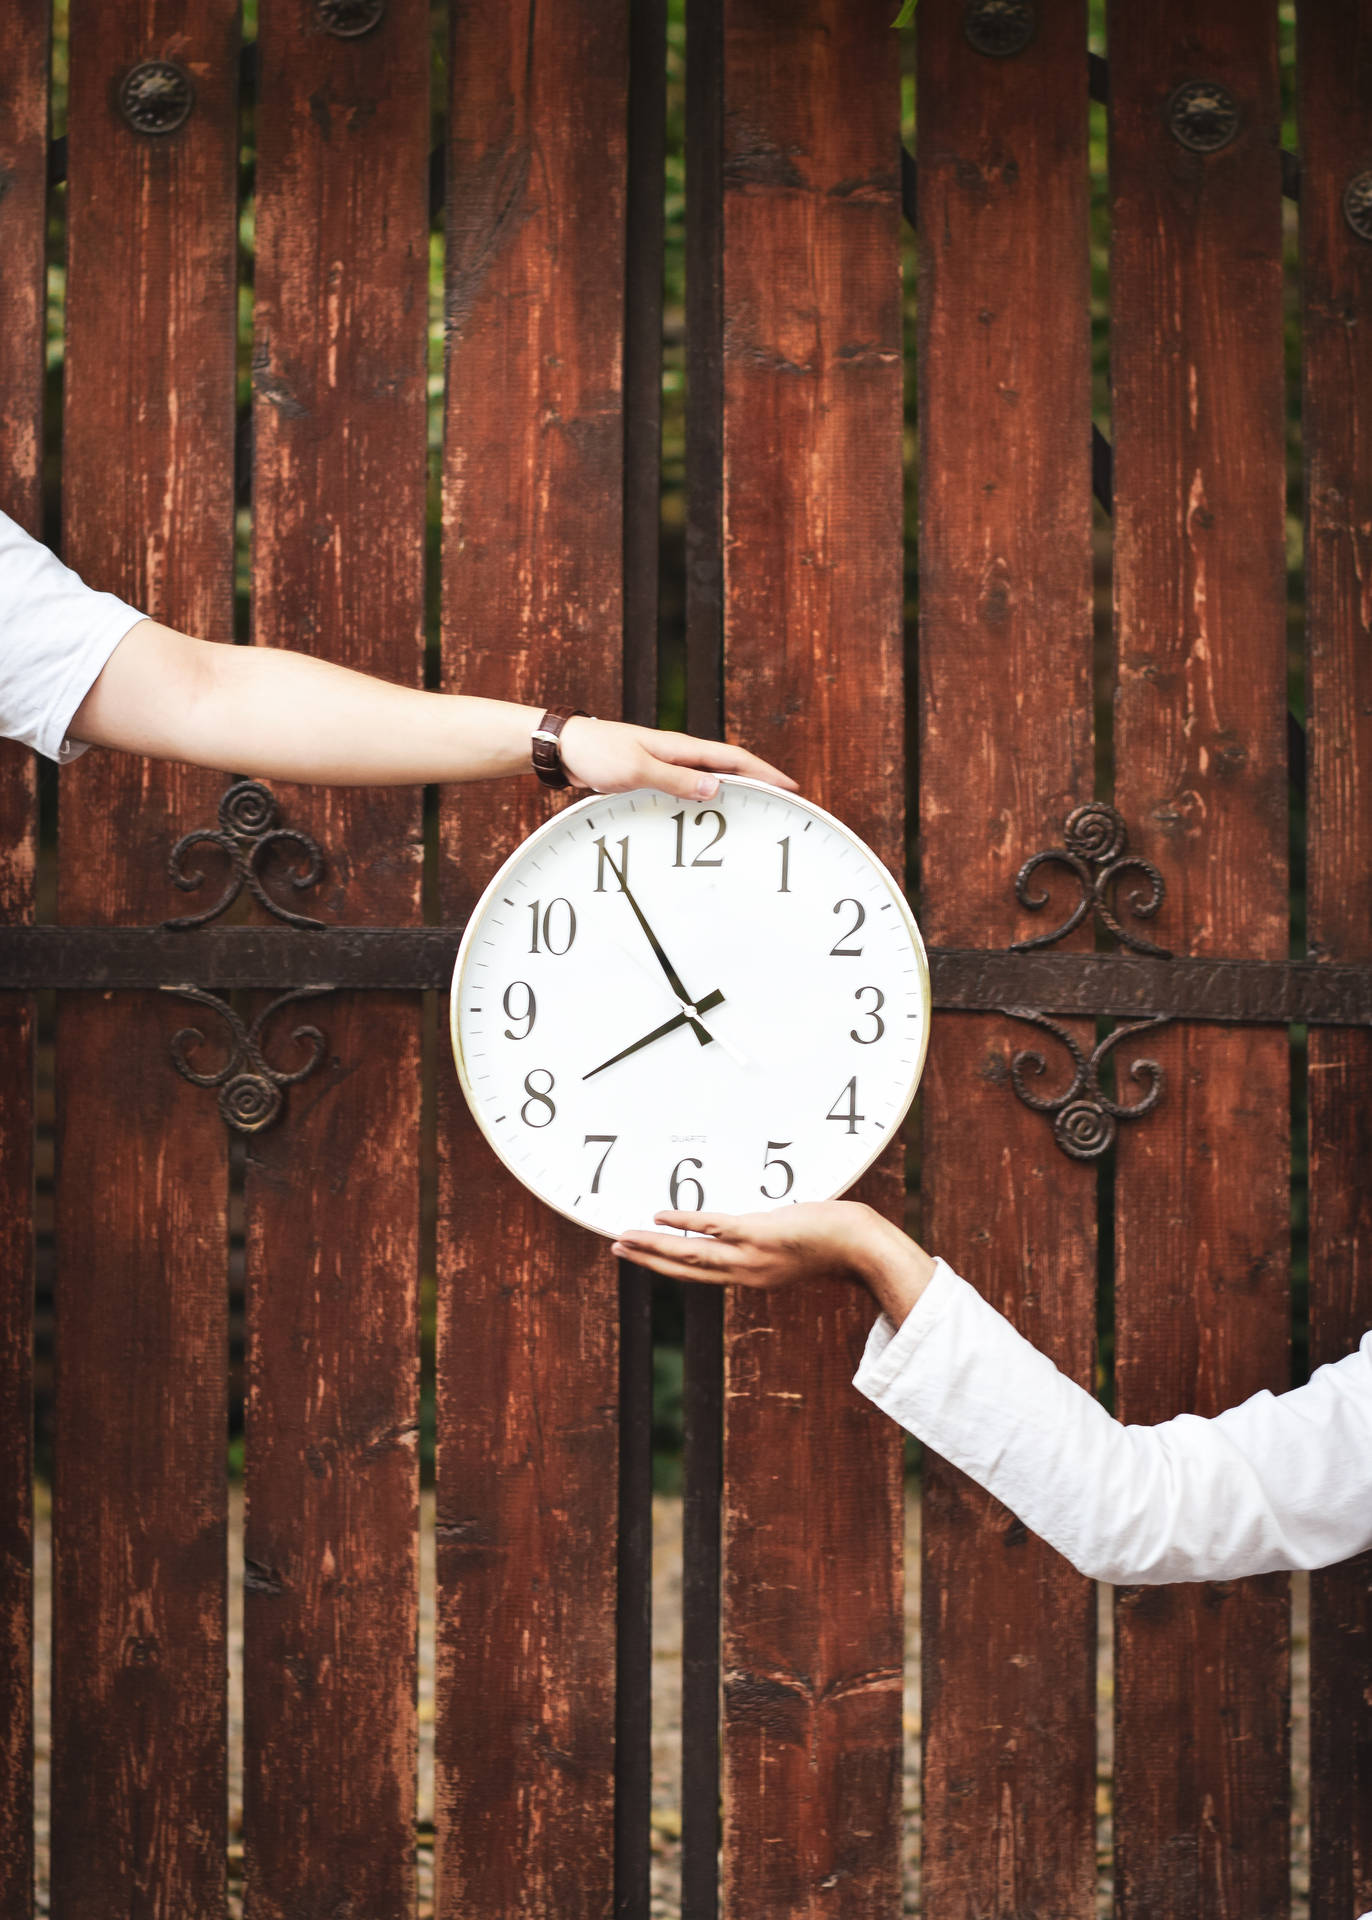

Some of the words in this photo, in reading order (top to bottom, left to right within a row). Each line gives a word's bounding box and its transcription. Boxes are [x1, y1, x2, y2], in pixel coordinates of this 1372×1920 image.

[593, 835, 629, 893] 11
[671, 809, 727, 867] 12
[777, 836, 791, 892] 1
[528, 898, 576, 955] 10
[829, 899, 865, 956] 2
[503, 981, 536, 1040] 9
[850, 986, 885, 1044] 3
[521, 1069, 556, 1128] 8
[826, 1076, 865, 1134] 4
[584, 1135, 617, 1193] 7
[670, 1158, 704, 1211] 6
[760, 1141, 794, 1199] 5
